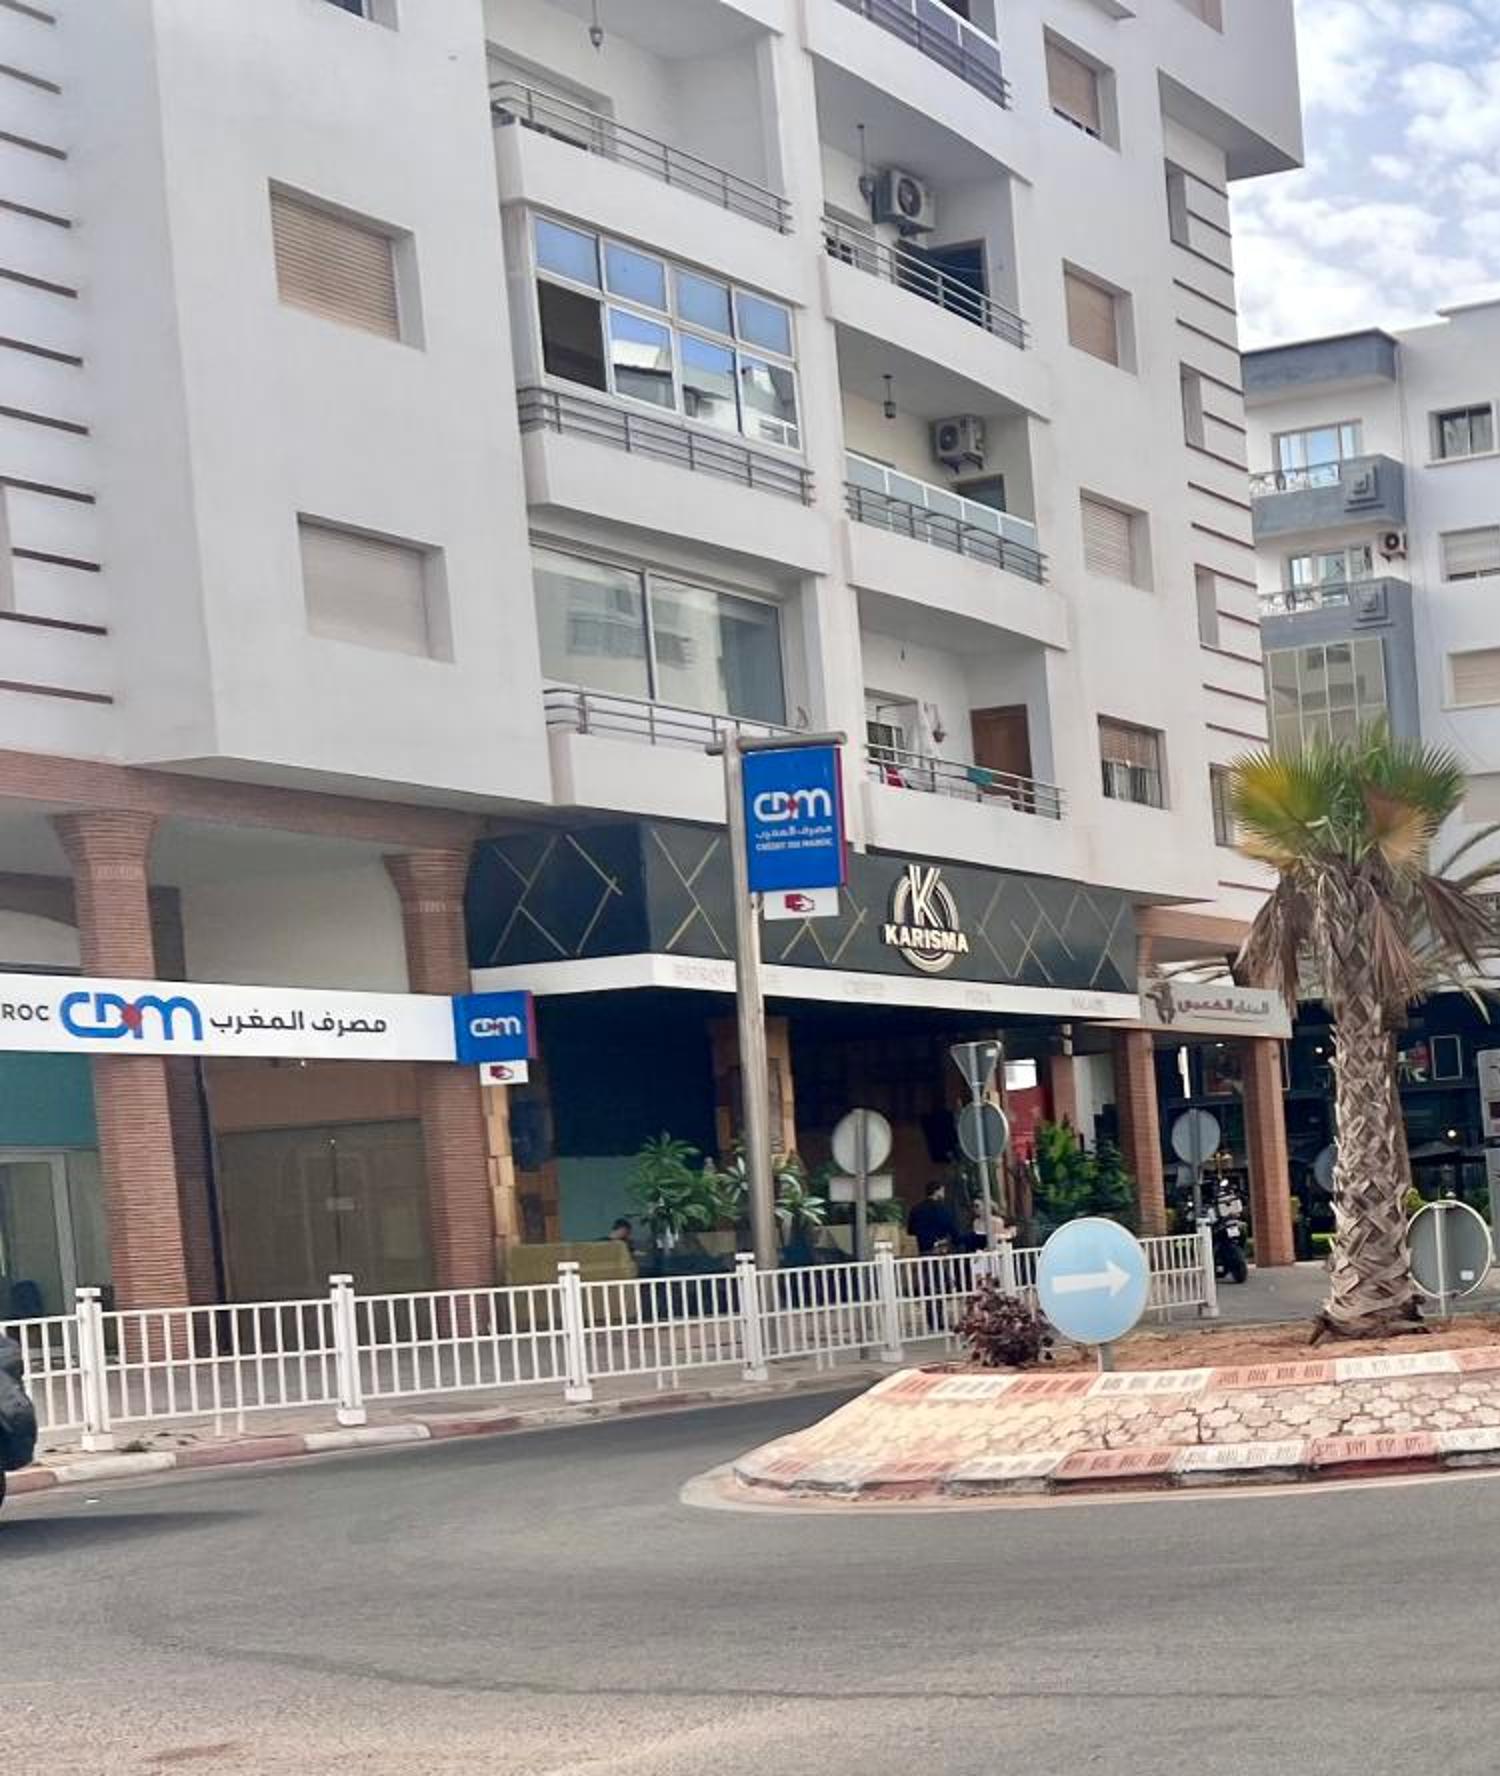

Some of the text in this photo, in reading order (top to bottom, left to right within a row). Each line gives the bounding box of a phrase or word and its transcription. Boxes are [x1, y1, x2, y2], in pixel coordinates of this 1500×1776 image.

[883, 923, 970, 954] KARISMA
[1, 1003, 50, 1022] ROC
[209, 1009, 387, 1038] مصرف المغرب
